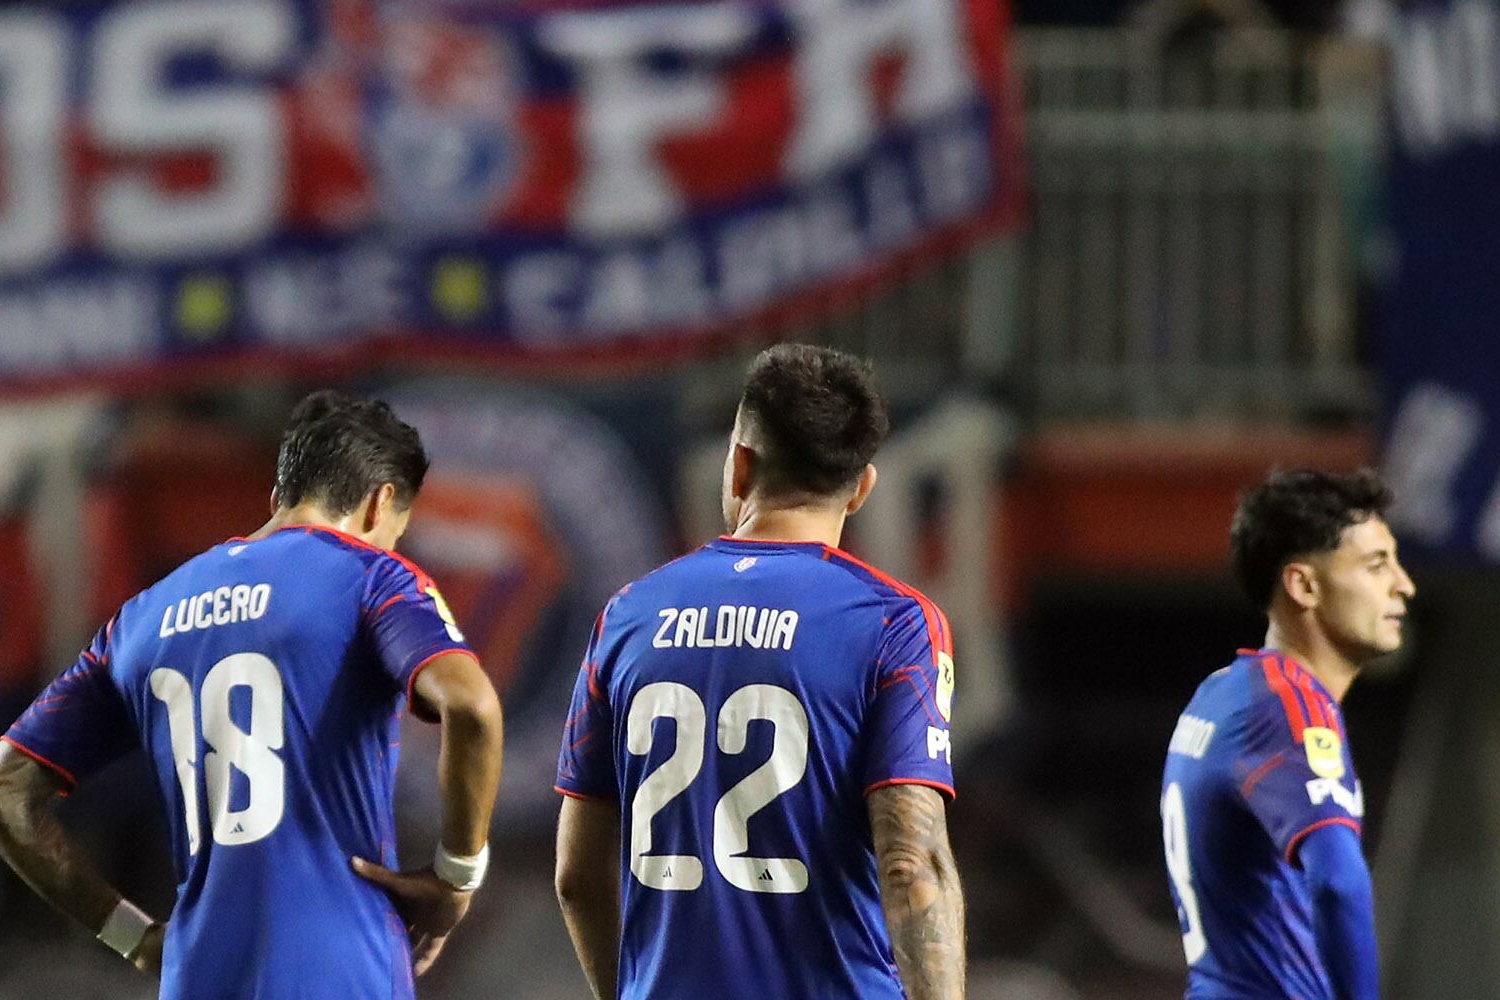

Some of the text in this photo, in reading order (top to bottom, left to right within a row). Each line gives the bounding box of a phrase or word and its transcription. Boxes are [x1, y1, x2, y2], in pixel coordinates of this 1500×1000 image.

[158, 583, 272, 640] LUCERO
[651, 605, 800, 651] ZALDIVIA
[149, 652, 285, 856] 18
[626, 681, 810, 895] 22
